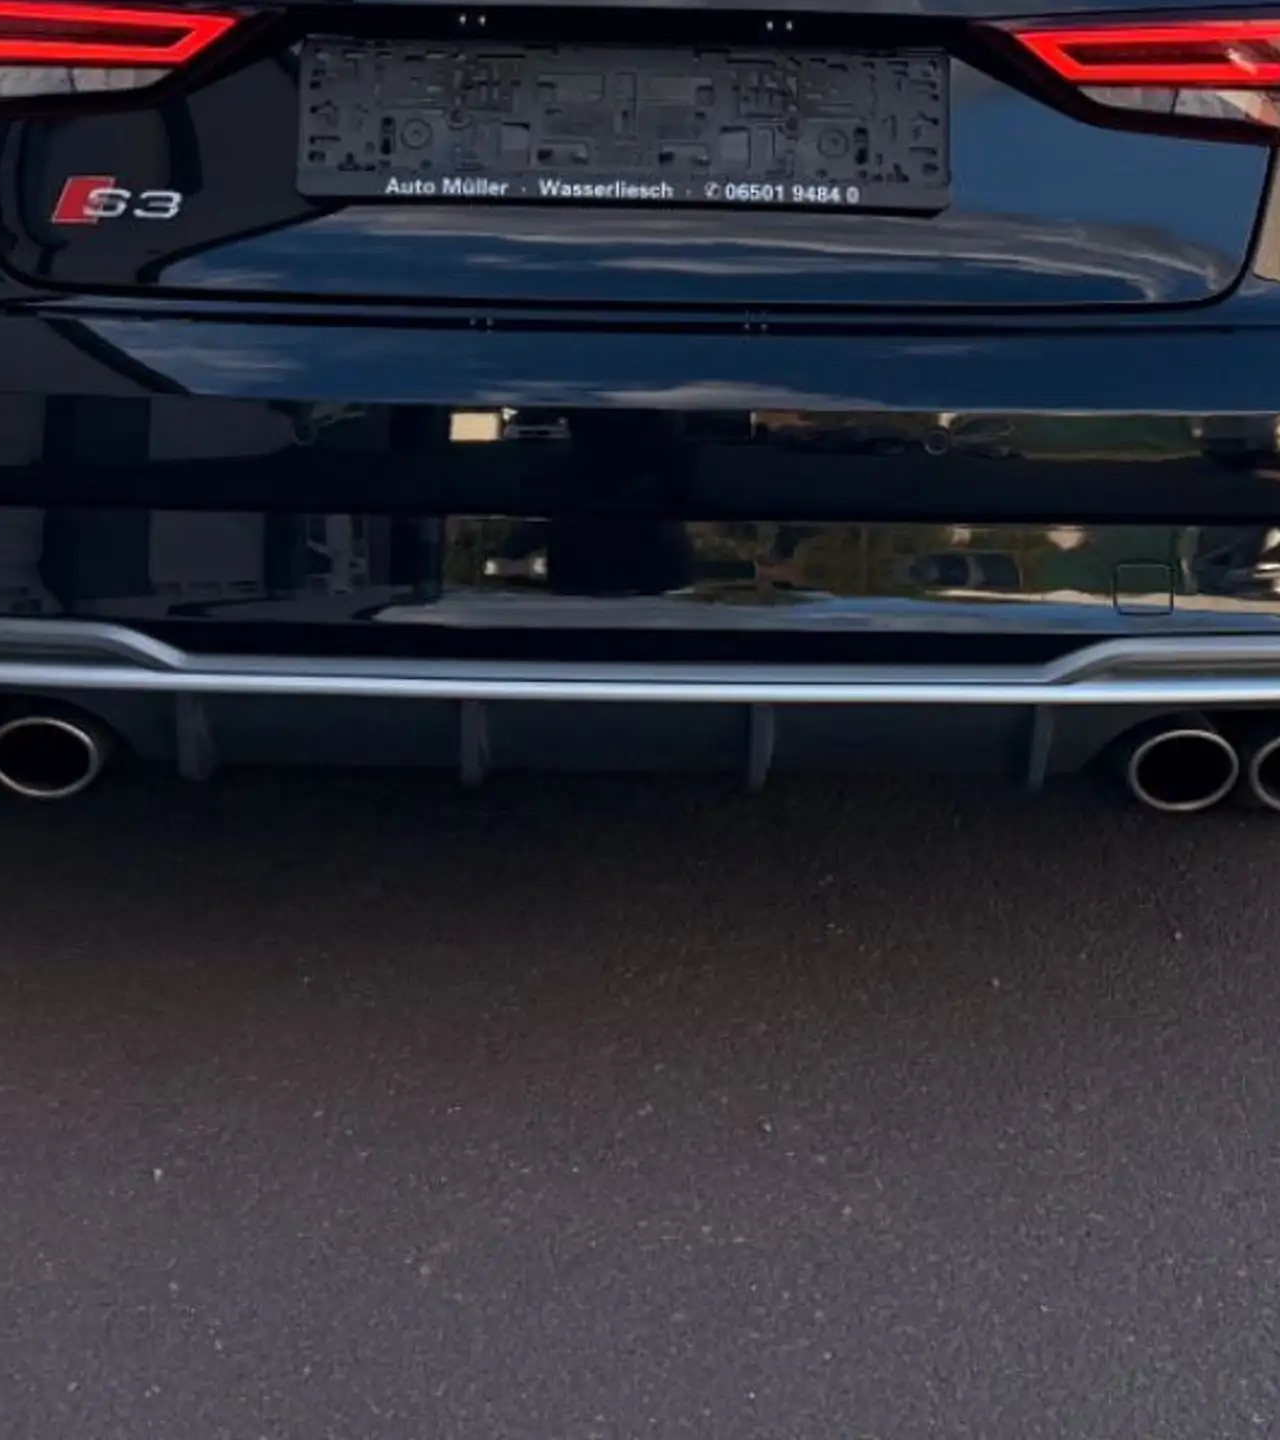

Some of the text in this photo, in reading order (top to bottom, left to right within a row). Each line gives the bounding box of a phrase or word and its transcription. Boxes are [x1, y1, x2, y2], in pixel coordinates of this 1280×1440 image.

[385, 176, 436, 195] Auto
[441, 176, 509, 196] Müller
[538, 177, 674, 200] Wasserliesch
[725, 182, 785, 201] 06501
[82, 187, 183, 219] S3
